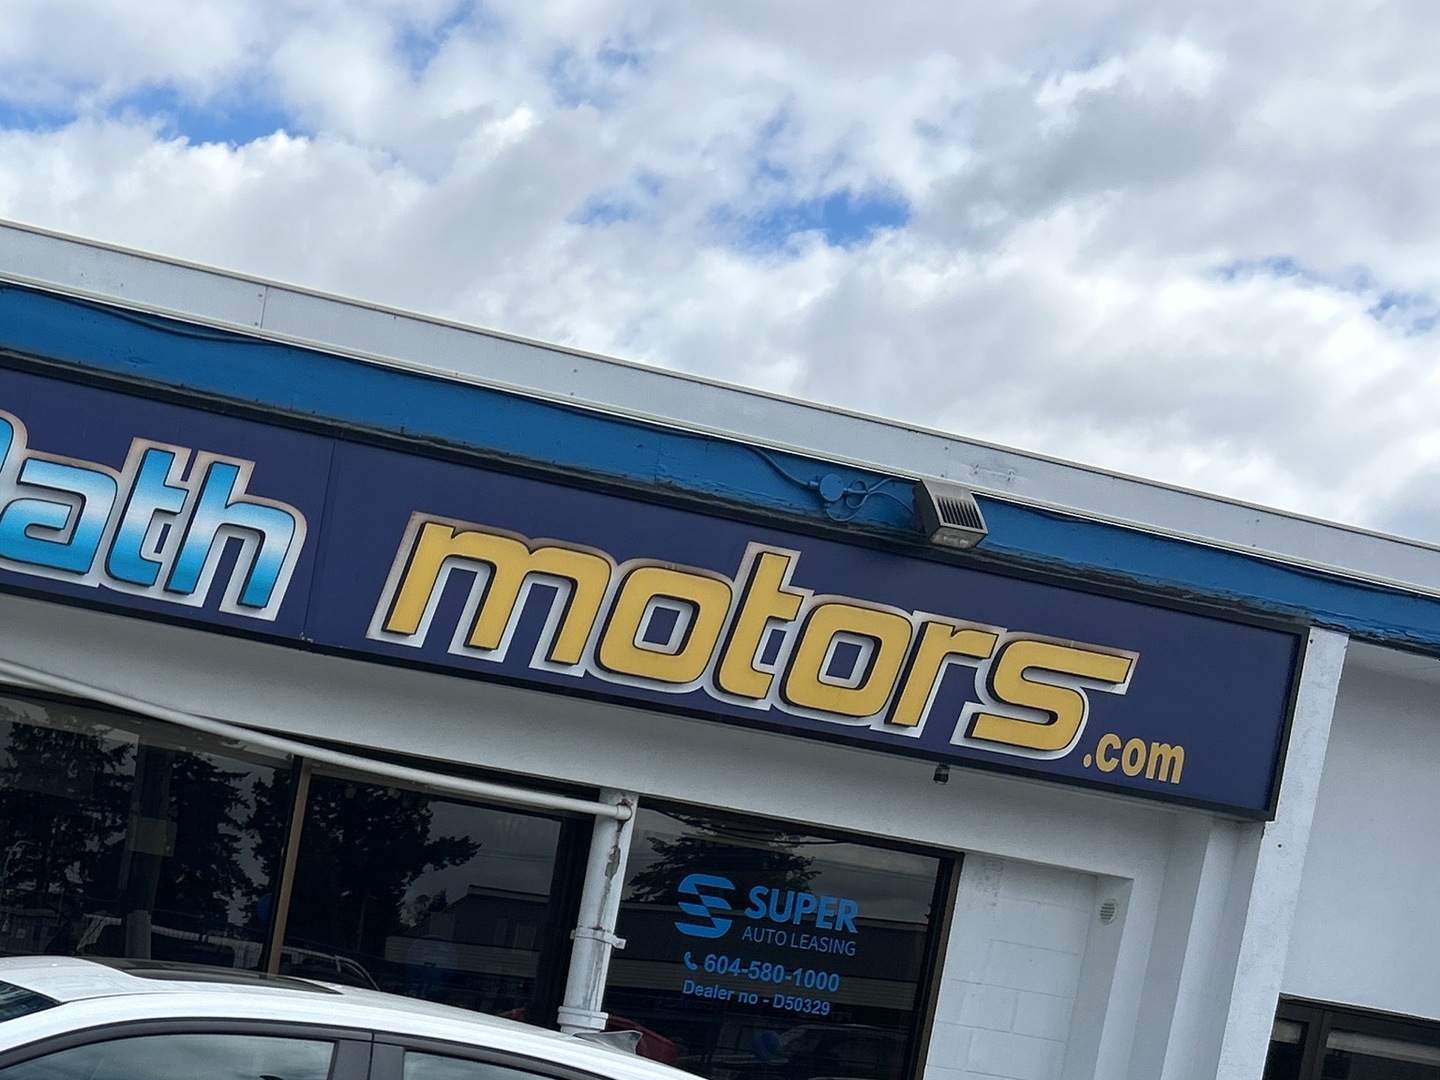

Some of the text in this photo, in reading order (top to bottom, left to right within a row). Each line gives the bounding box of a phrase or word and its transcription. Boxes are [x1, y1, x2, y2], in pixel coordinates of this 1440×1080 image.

[365, 510, 1140, 761] motors
[1082, 733, 1186, 784] .com
[744, 885, 859, 934] SUPER
[741, 926, 857, 957] AUTO LEASING
[703, 953, 841, 993] 604-580-1000
[682, 979, 735, 1001] Dealer
[738, 990, 759, 1005] no
[773, 993, 831, 1016] D50329
